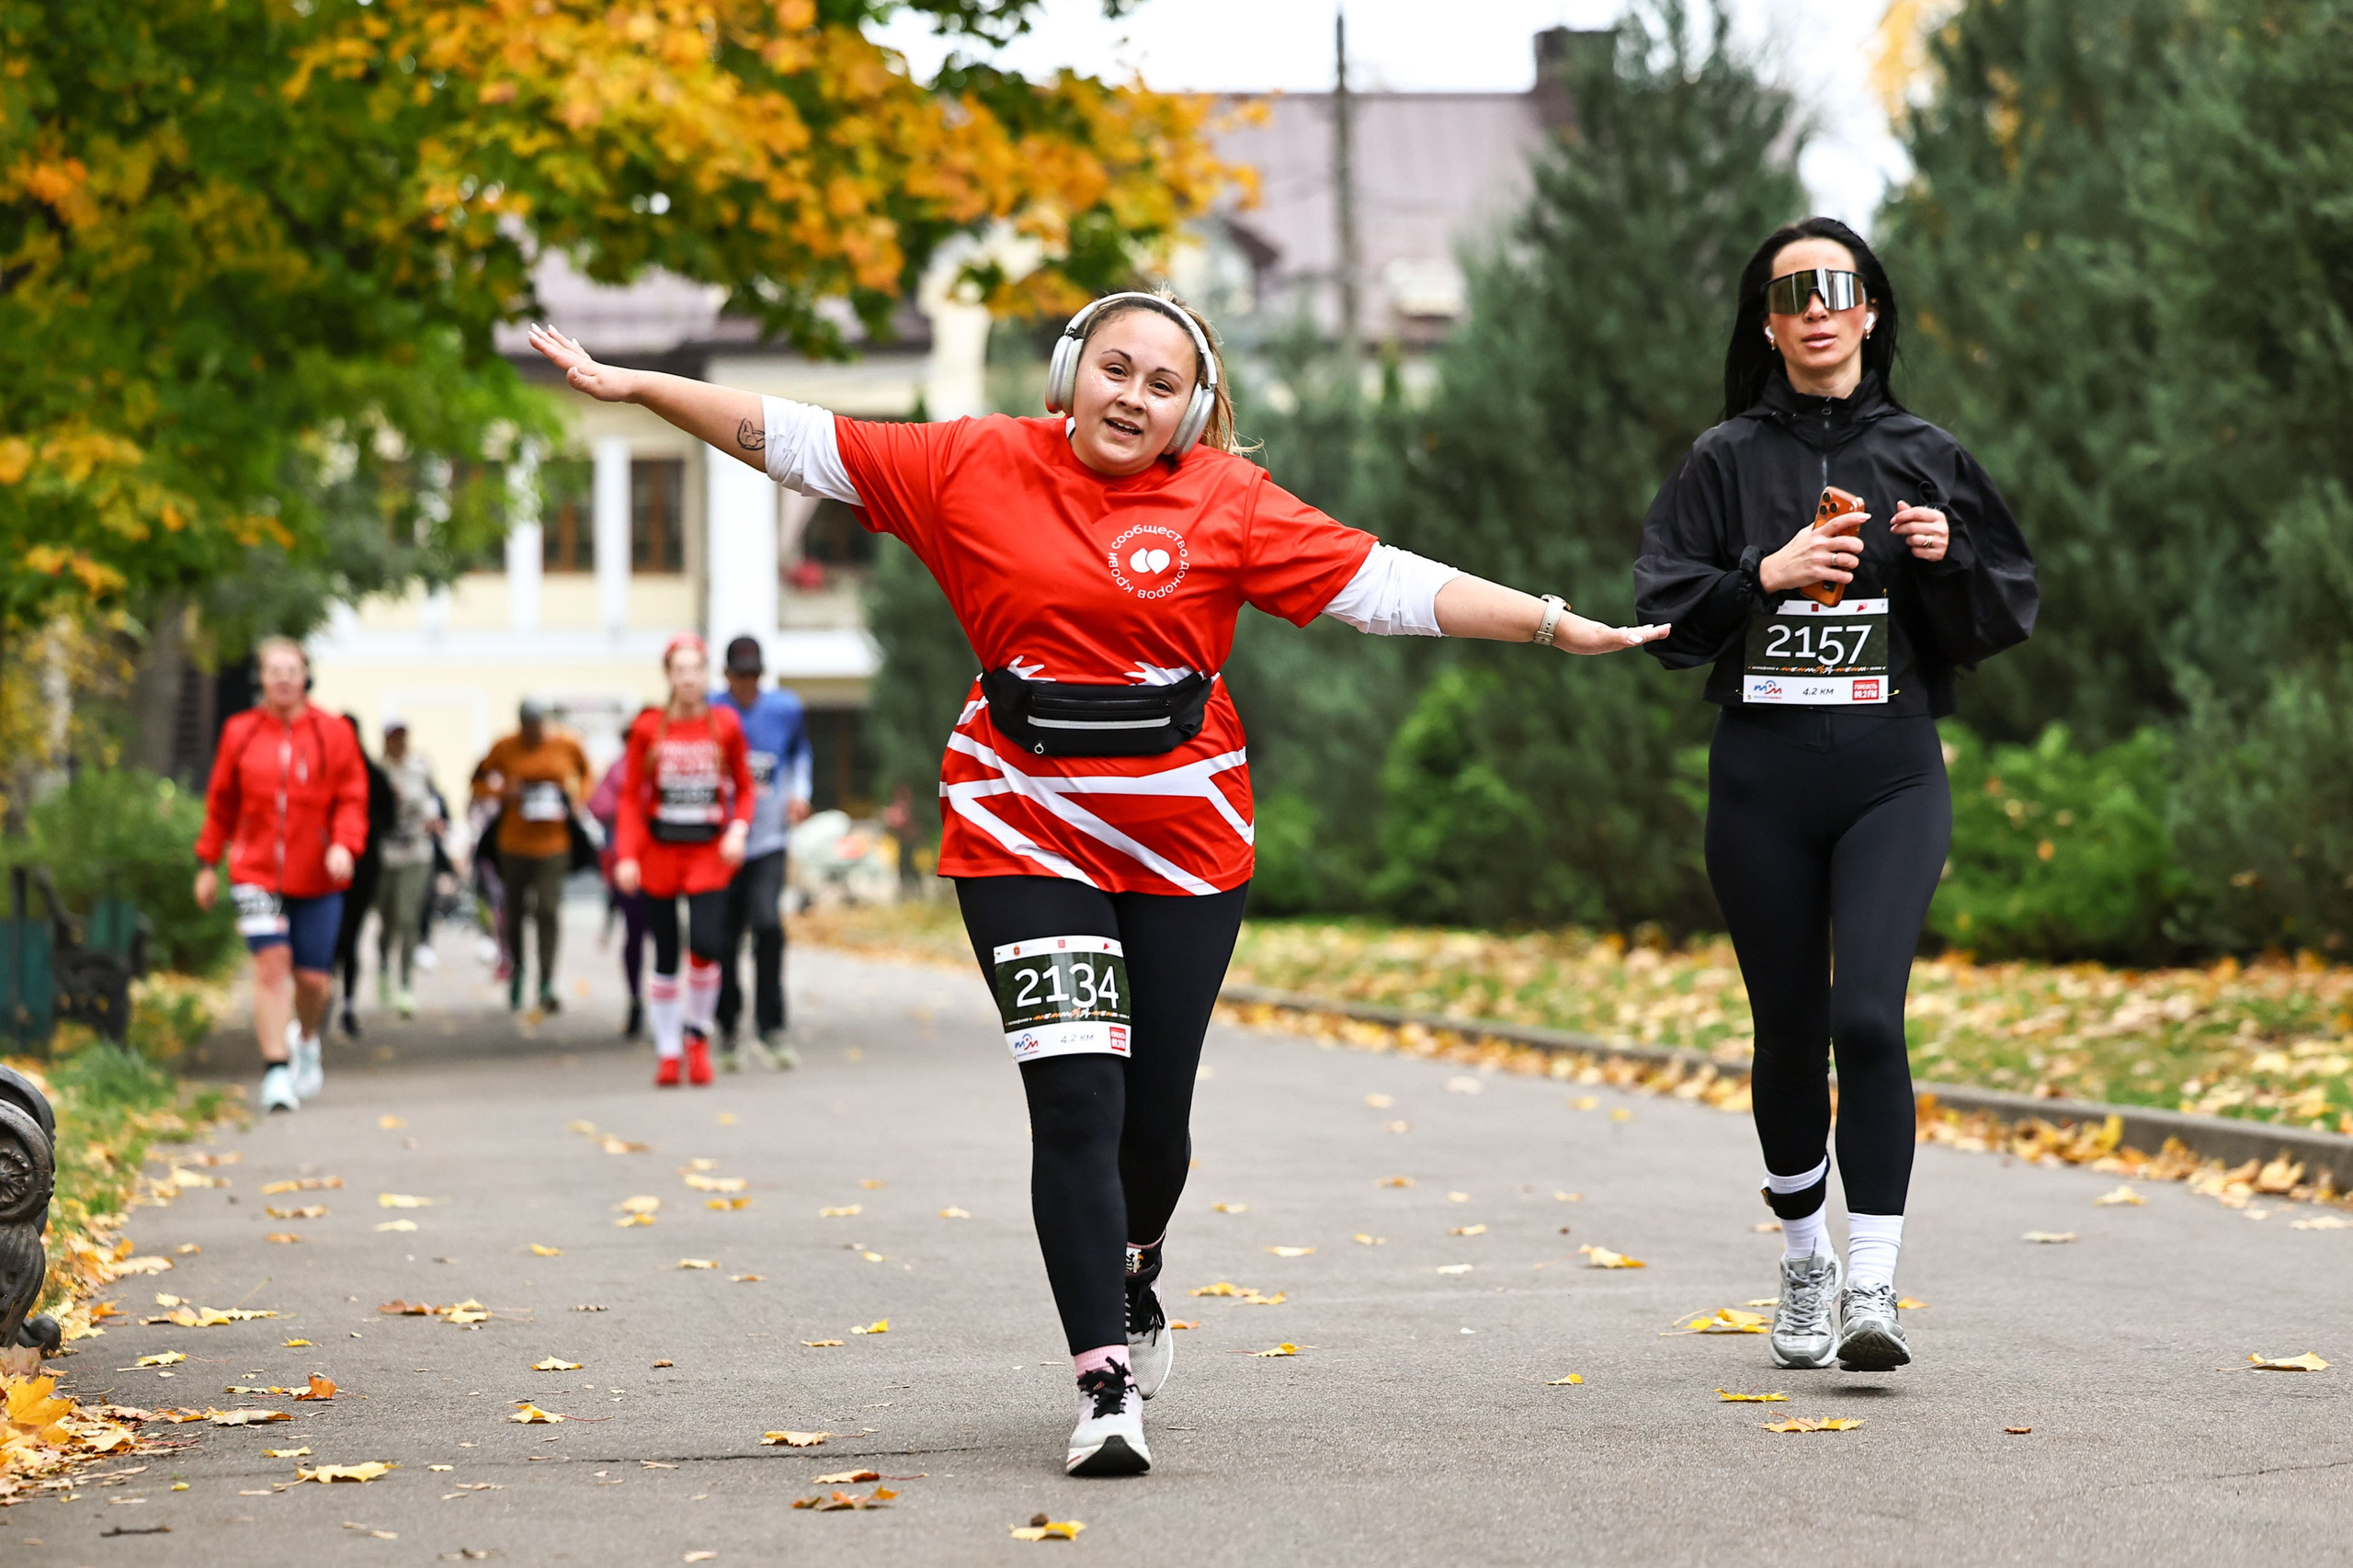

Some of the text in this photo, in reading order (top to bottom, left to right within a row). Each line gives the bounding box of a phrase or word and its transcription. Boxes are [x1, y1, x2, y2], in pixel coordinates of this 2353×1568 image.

[1108, 524, 1190, 599] сообщество доноров крови
[1765, 624, 1873, 666] 2157
[1802, 687, 1817, 696] 4.2
[1014, 962, 1120, 1009] 2134
